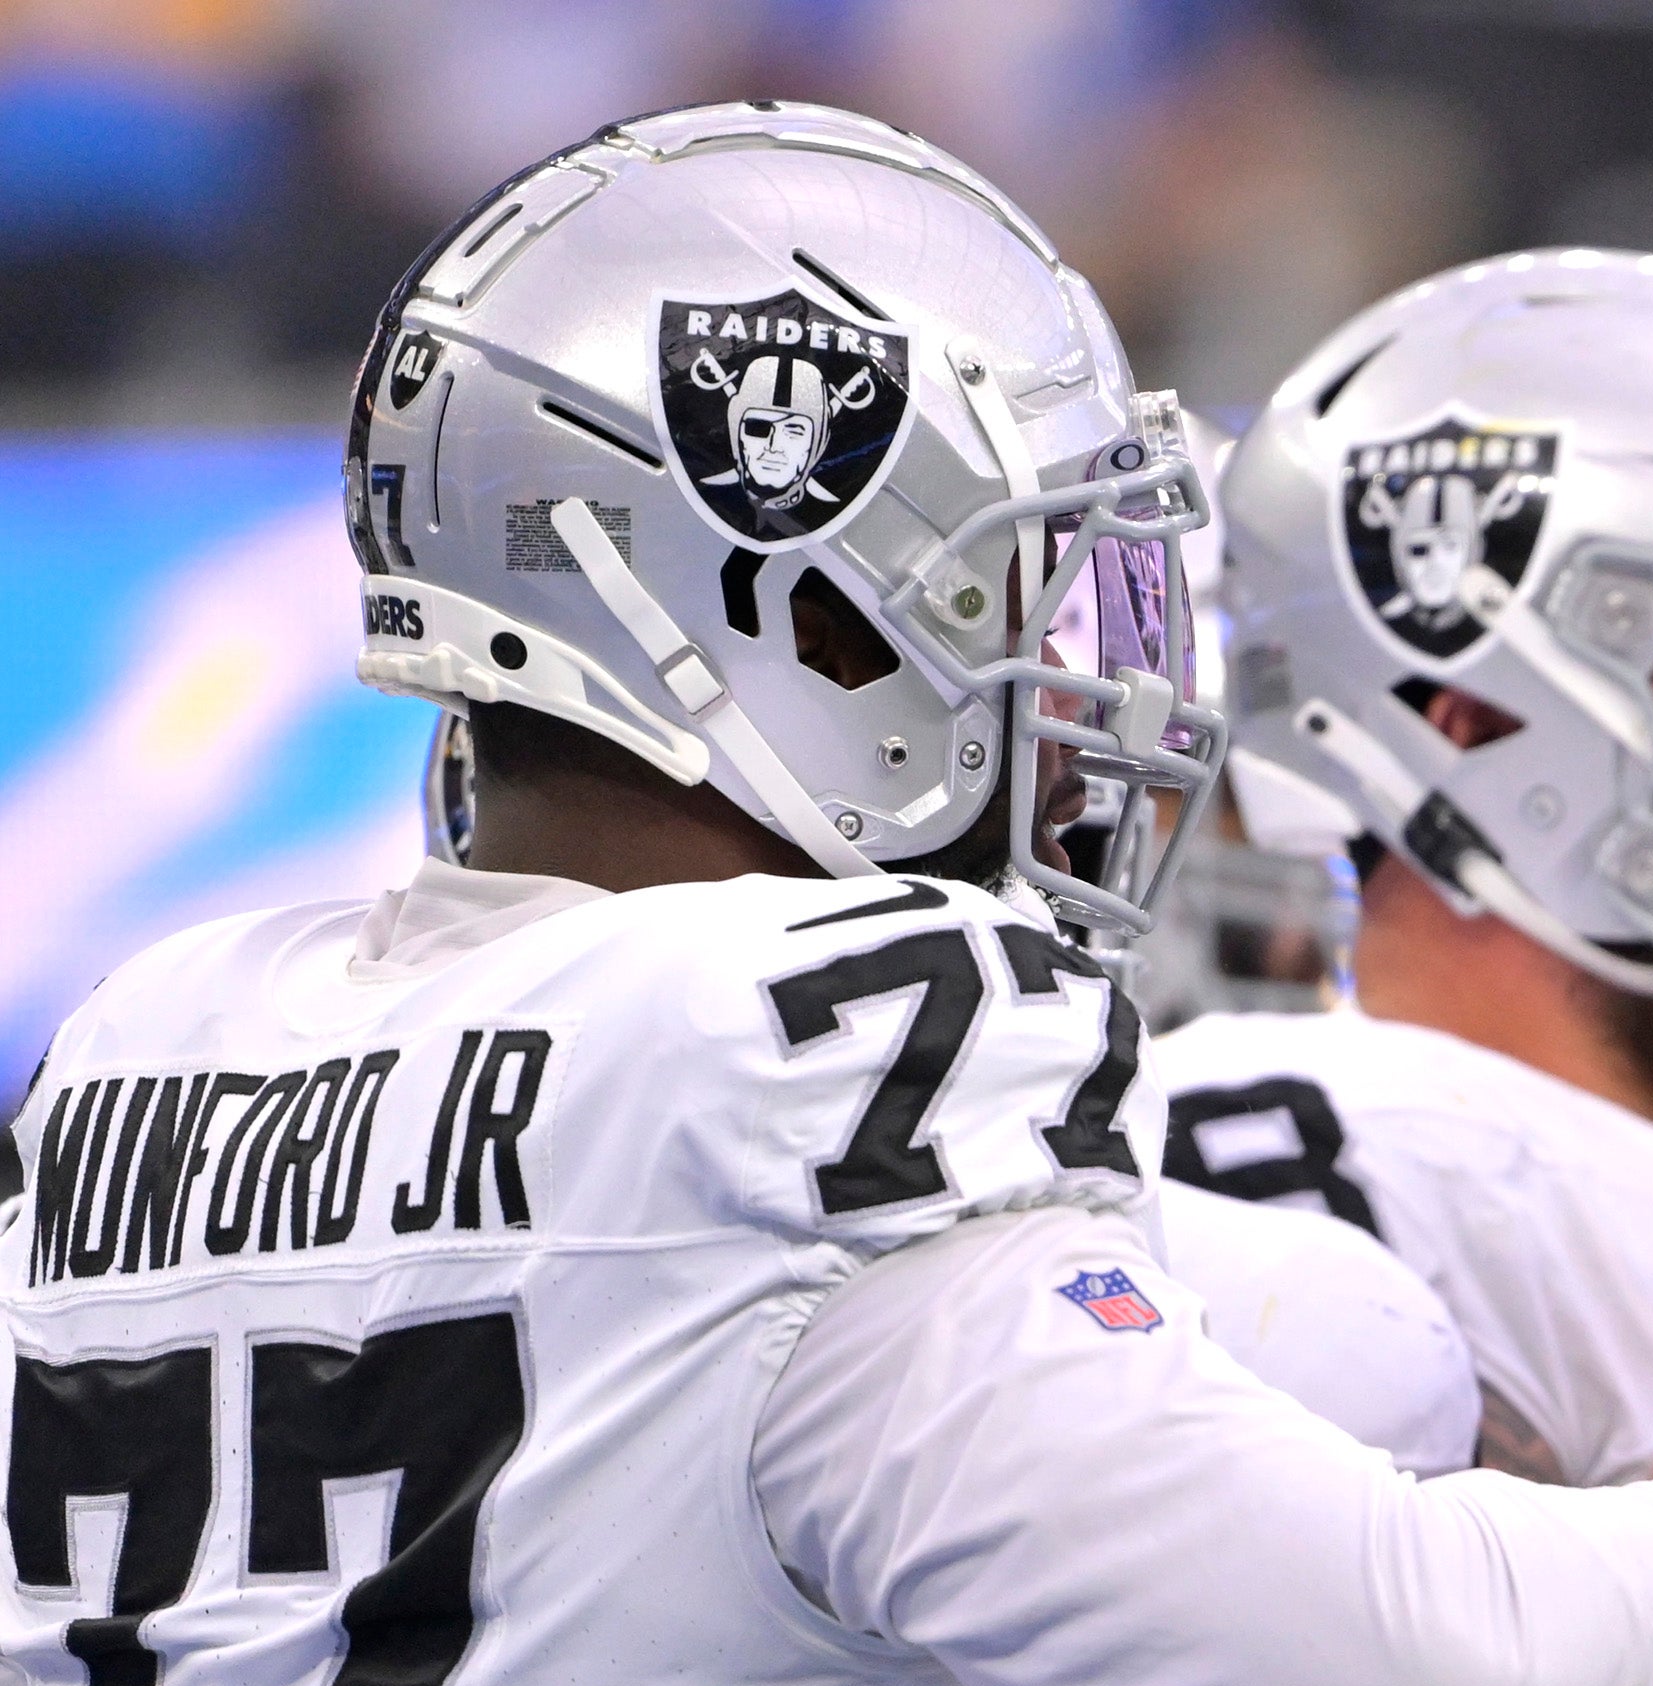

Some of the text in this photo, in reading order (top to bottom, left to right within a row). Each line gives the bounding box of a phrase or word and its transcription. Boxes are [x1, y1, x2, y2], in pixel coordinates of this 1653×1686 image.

[686, 309, 888, 359] RAIDERS
[396, 345, 426, 380] AL
[766, 922, 1143, 1217] 77
[27, 1029, 553, 1289] MUNFORD JR
[1085, 1295, 1158, 1327] NFL
